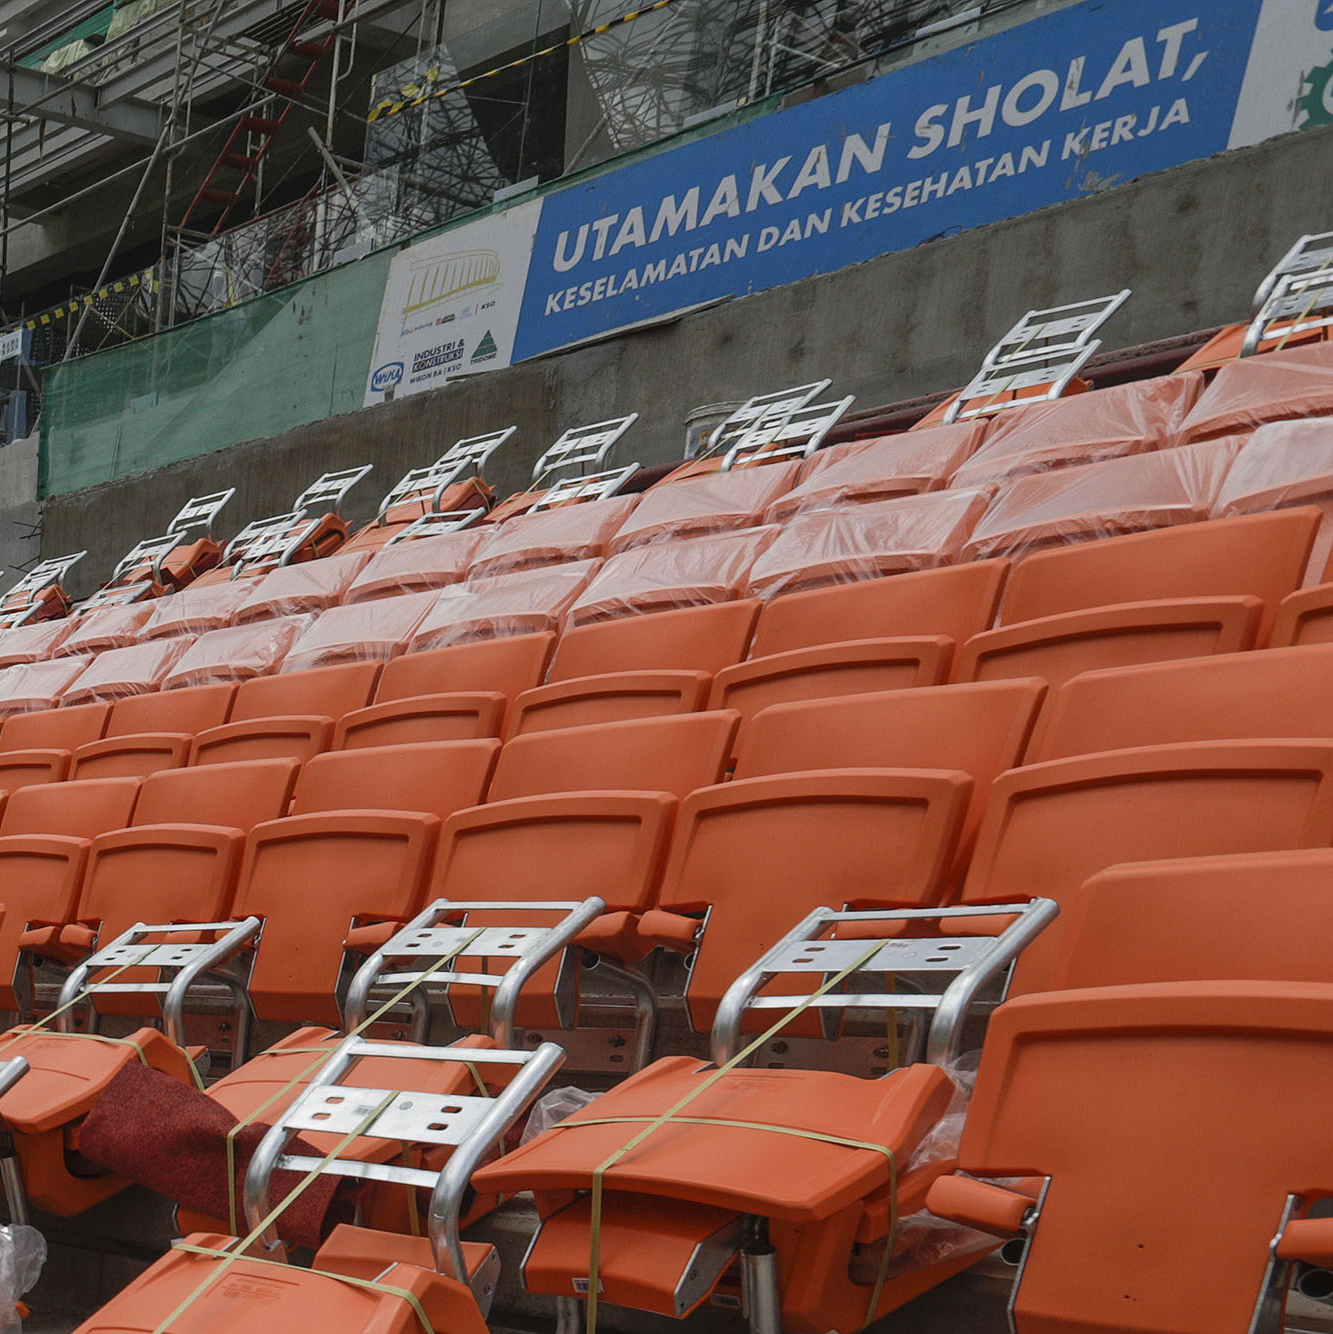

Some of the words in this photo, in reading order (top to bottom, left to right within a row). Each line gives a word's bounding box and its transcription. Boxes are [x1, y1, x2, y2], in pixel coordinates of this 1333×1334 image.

[552, 122, 892, 272] UTAMAKAN
[906, 18, 1209, 160] SHOLAT,
[544, 234, 749, 316] KESELAMATAN
[756, 208, 832, 253] DAN
[840, 140, 1051, 228] KESEHATAN
[1061, 97, 1190, 161] KERJA
[481, 301, 496, 310] KSO
[413, 348, 464, 373] KONSTRUKSI
[414, 341, 456, 361] INDUSTRI
[458, 338, 465, 347] &
[447, 363, 462, 373] KSO
